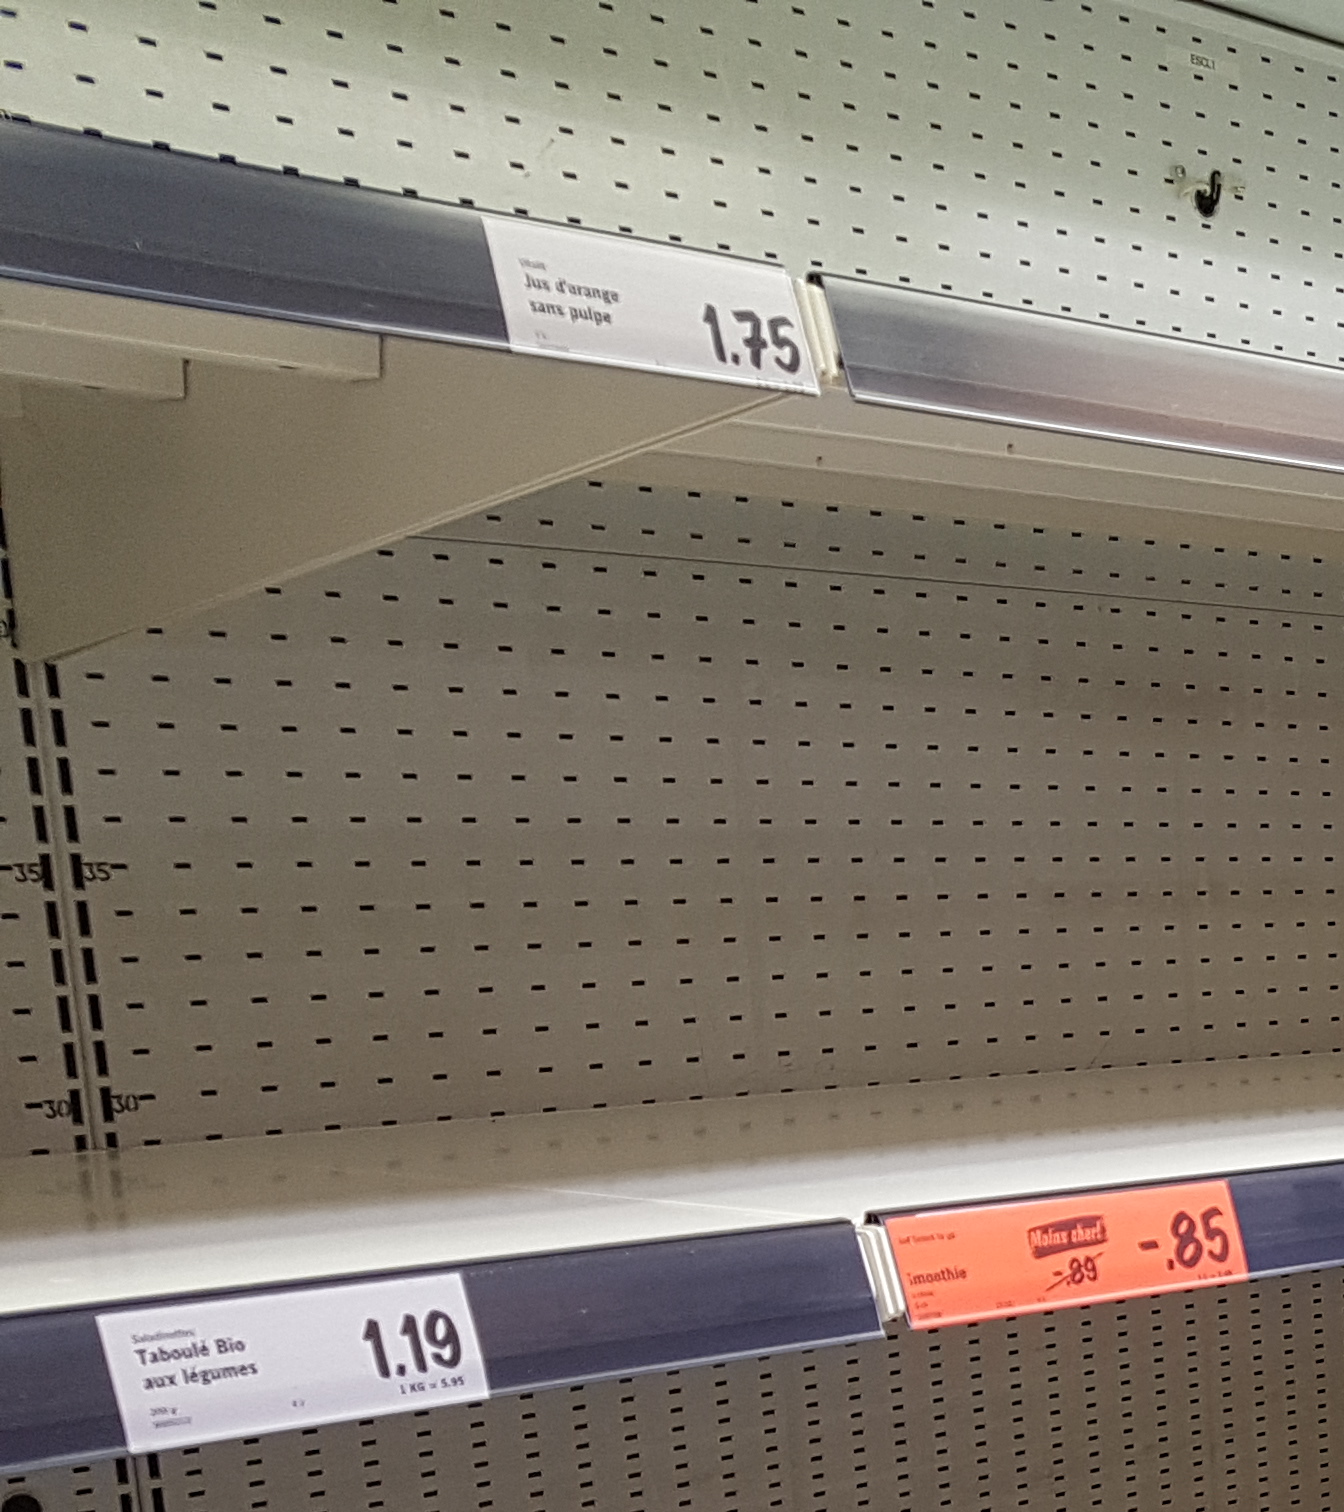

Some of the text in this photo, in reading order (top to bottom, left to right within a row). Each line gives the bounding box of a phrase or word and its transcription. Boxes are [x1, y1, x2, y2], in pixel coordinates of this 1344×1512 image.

[524, 272, 619, 304] Jus d'orange
[528, 300, 611, 326] sans pulpe
[703, 303, 800, 373] 1.75
[1030, 1227, 1068, 1249] Moins
[134, 1337, 246, 1365] Taboulé Bio
[363, 1310, 461, 1379] 1.19
[143, 1363, 258, 1390] aux légumes
[440, 1376, 464, 1388] 5.95
